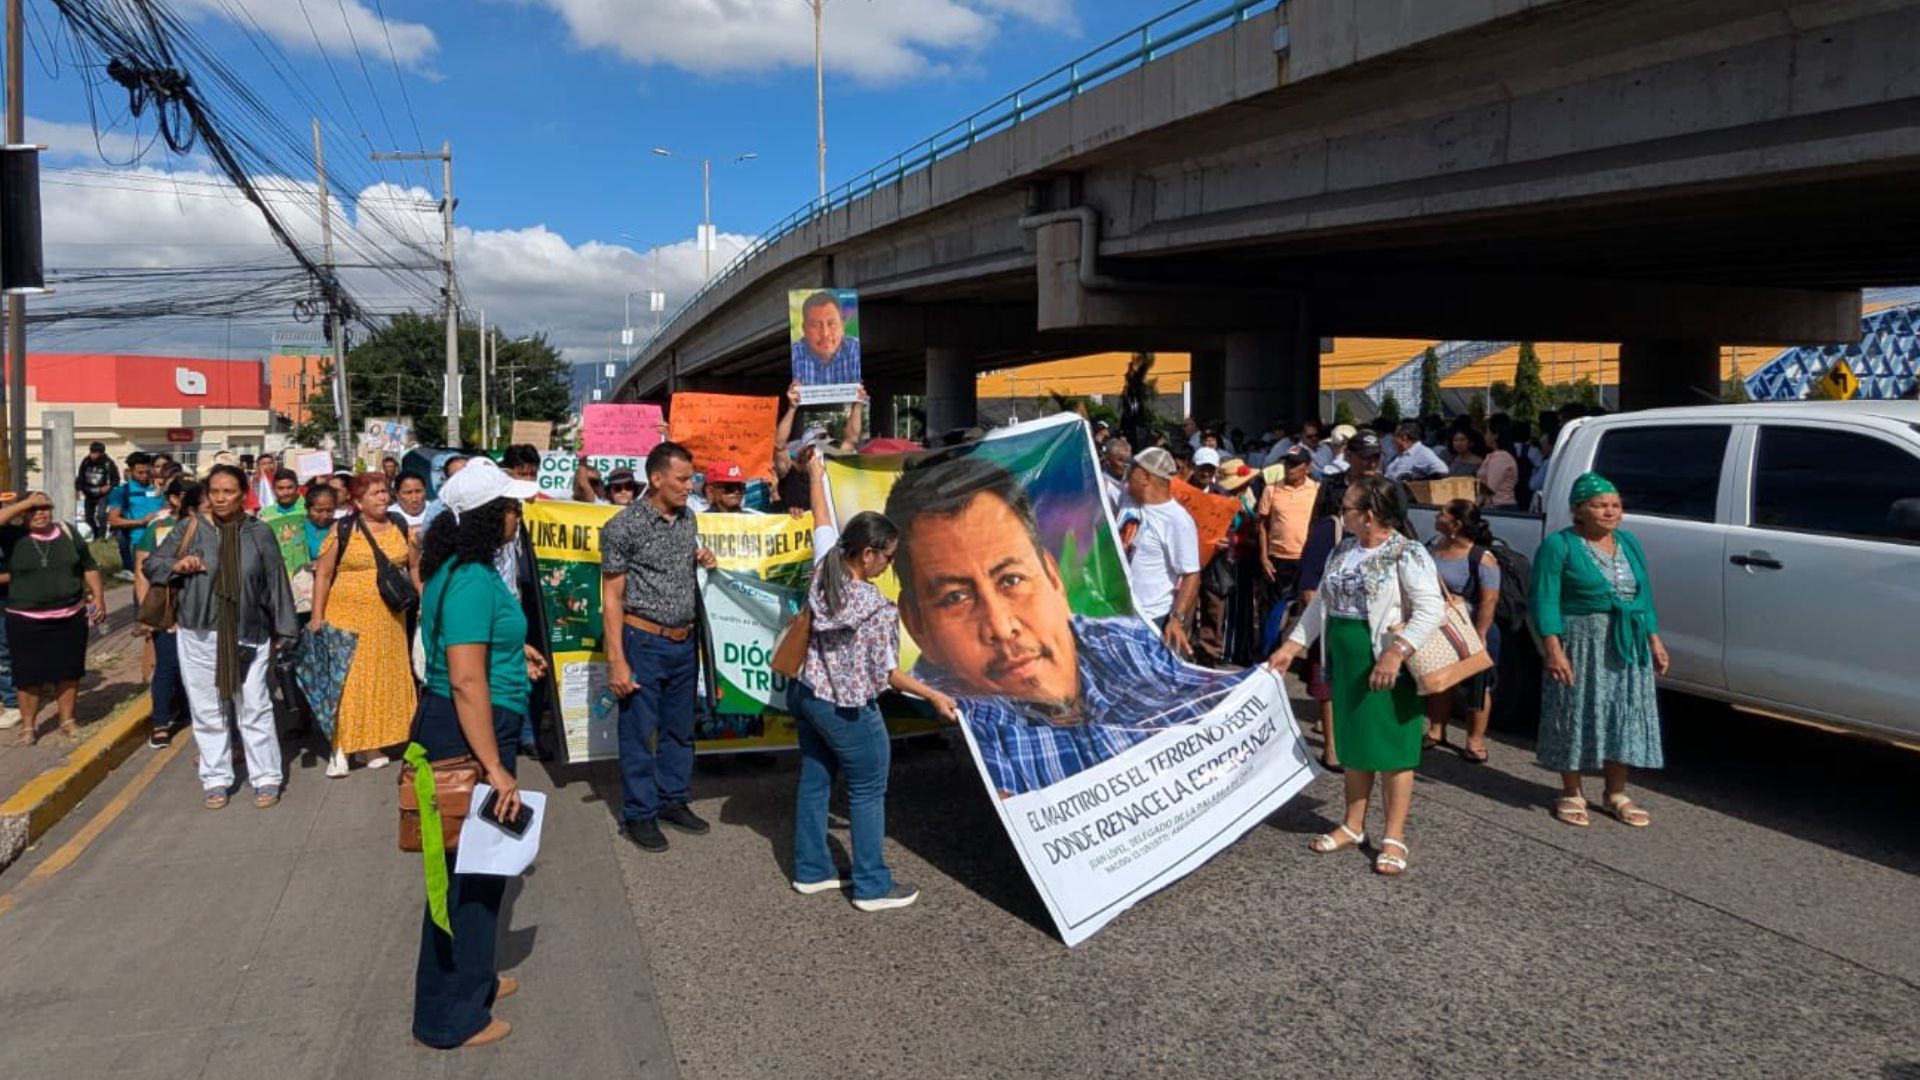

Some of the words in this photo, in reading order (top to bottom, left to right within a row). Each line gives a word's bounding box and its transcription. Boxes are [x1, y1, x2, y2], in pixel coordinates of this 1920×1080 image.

[615, 458, 637, 471] DE
[573, 525, 592, 551] DE
[766, 533, 790, 556] DEL
[1026, 810, 1046, 832] EL
[1041, 783, 1110, 828] MARTIRIO
[1107, 773, 1130, 797] ES
[1125, 765, 1150, 788] EL
[1145, 725, 1224, 775] TERRENO
[1042, 823, 1099, 865] DONDE
[1095, 790, 1169, 841] RENACE
[1162, 779, 1193, 805] LA
[1187, 717, 1277, 789] ESPERANZA
